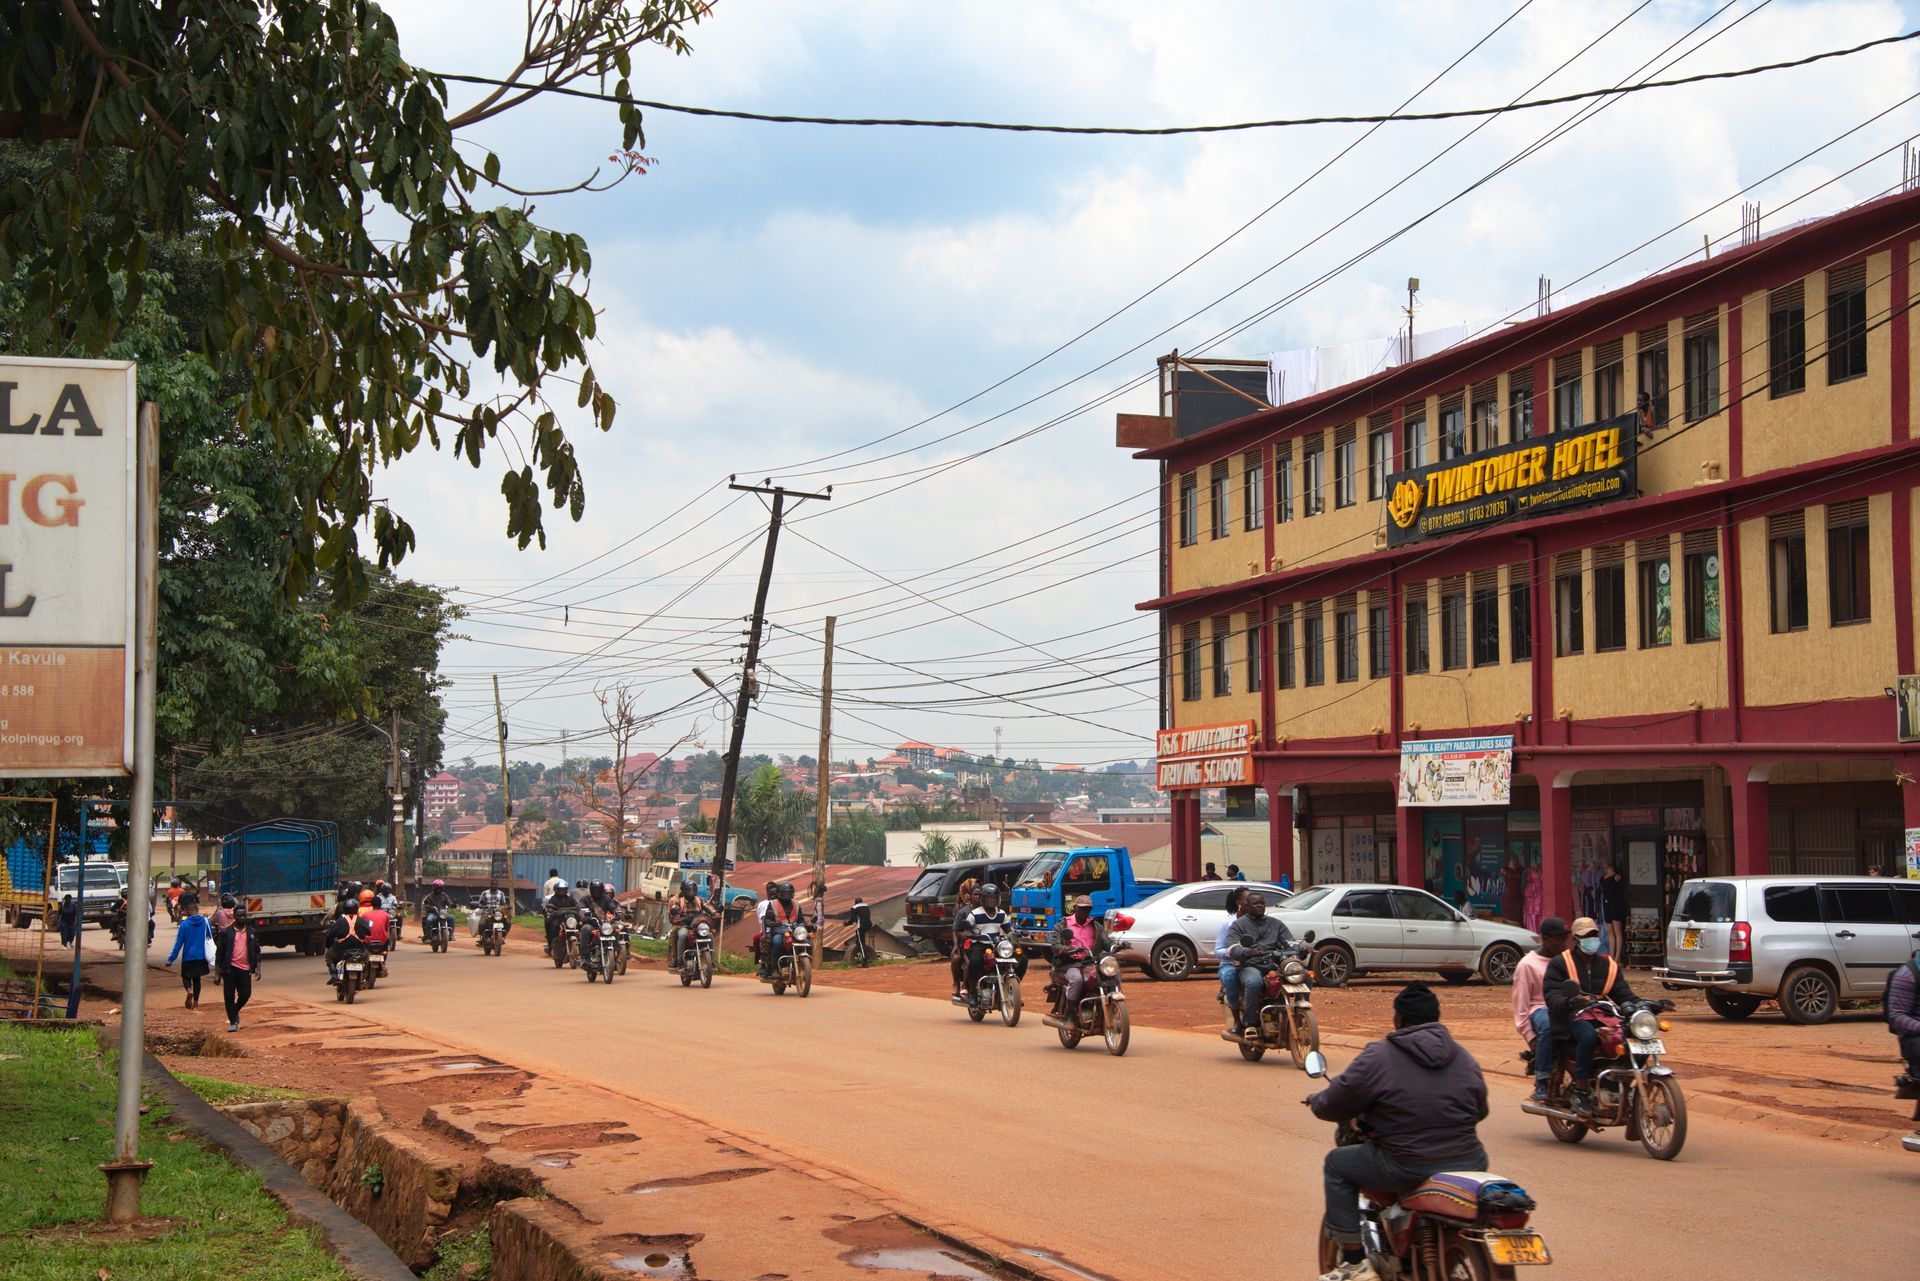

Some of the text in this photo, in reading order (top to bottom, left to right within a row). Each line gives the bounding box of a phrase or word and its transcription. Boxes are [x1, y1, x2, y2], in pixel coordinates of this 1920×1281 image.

[1426, 427, 1624, 507] TWINTOWER HOTEL
[13, 685, 34, 696] 586
[1, 733, 84, 745] kolpingug.org
[1181, 725, 1249, 753] TWINTOWER
[1402, 738, 1512, 753] ZION BRIDAL & BEAUTY PARLOUR LADIES SALON
[1160, 757, 1246, 787] DRIVING SCHOOL
